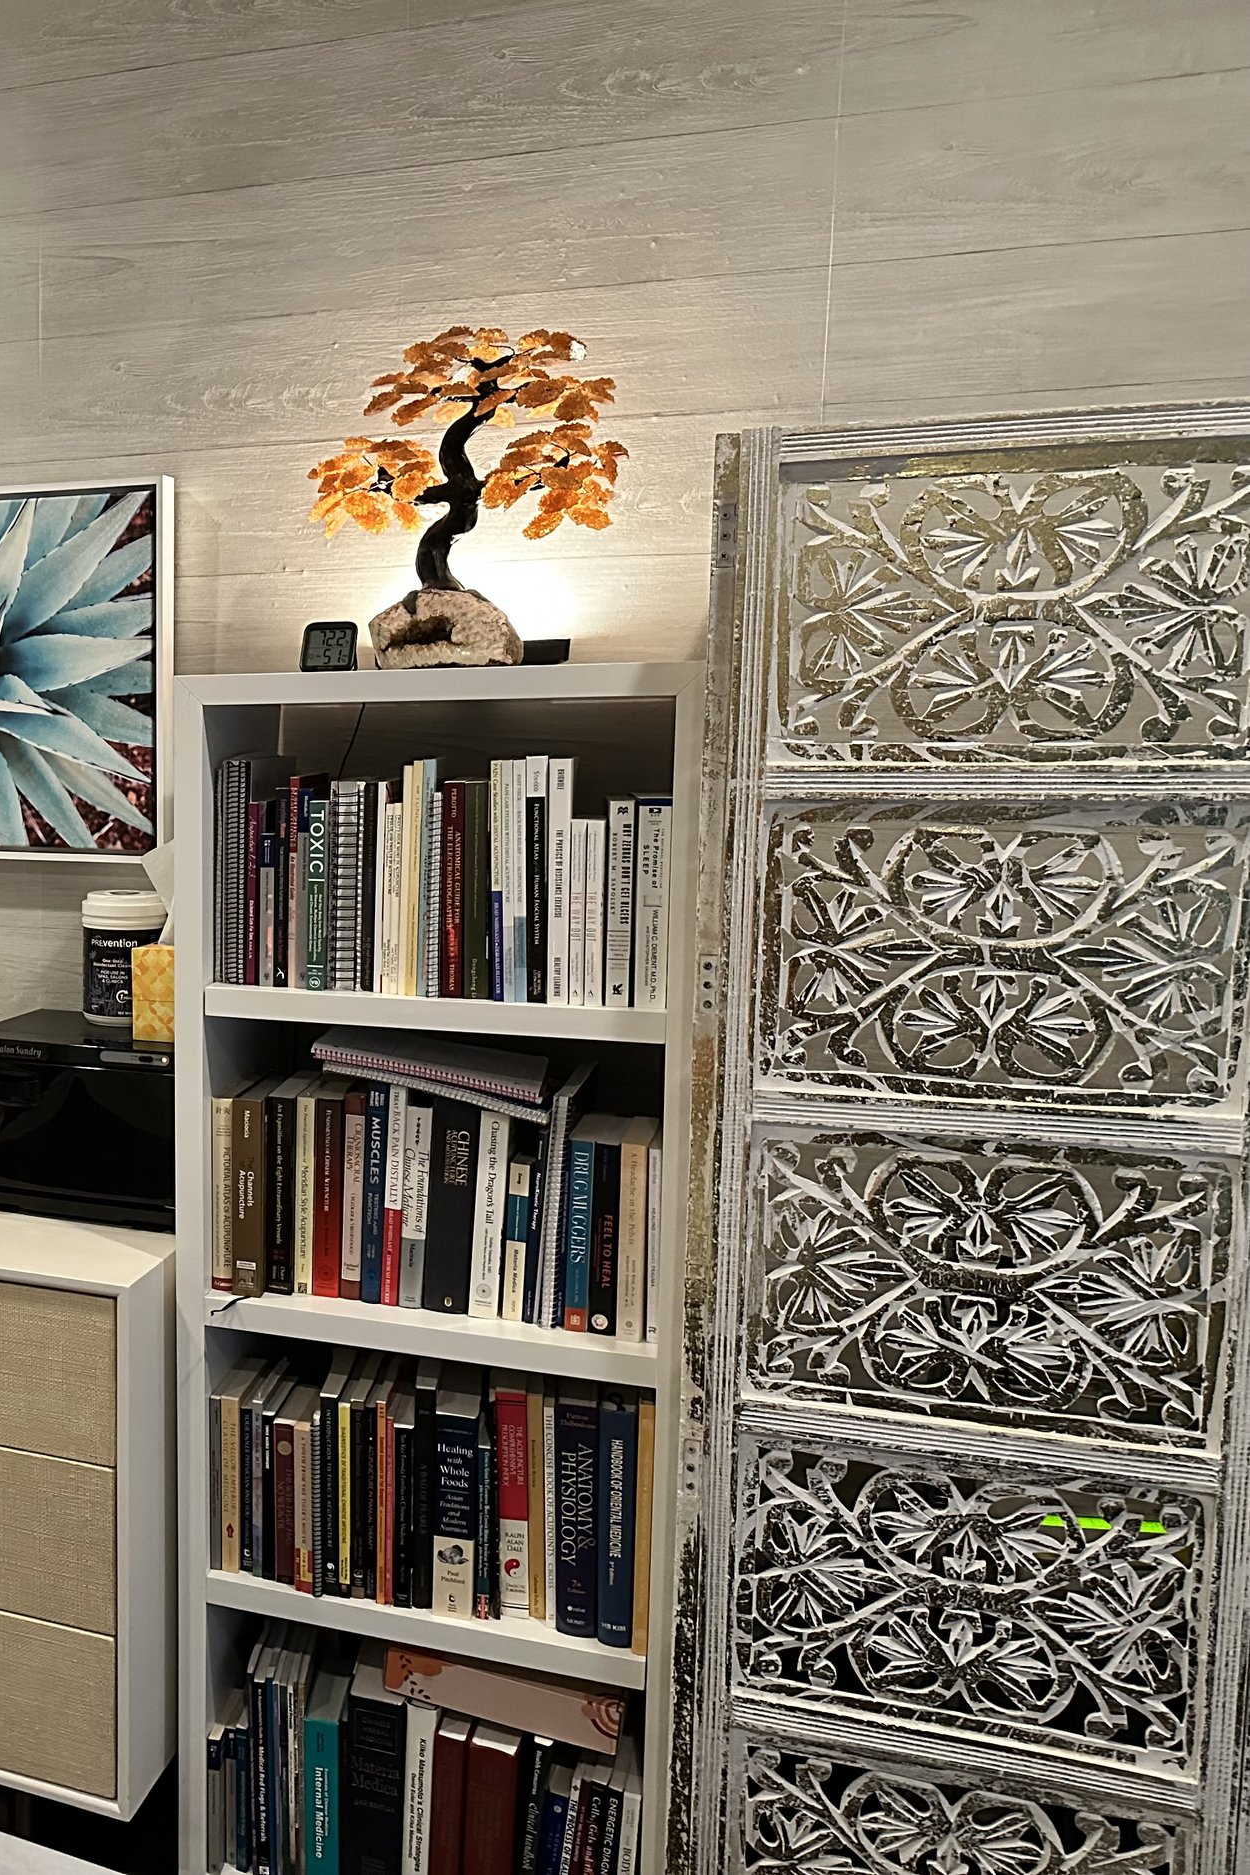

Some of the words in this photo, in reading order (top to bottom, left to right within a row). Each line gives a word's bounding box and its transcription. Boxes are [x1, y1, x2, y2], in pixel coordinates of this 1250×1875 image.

[310, 810, 324, 873] TOXIC
[556, 830, 564, 838] THE
[623, 824, 632, 837] WHY
[556, 840, 564, 860] PHYSICS
[622, 840, 631, 863] ZEBRAS
[652, 846, 660, 878] Promise
[555, 868, 564, 896] RESISTANCE
[620, 888, 630, 898] GET
[652, 880, 658, 888] of
[554, 897, 563, 918] EXERCISE
[571, 892, 581, 905] THE
[587, 892, 597, 905] THE
[571, 909, 581, 924] WAY
[587, 909, 597, 924] WAY
[620, 902, 630, 925] ULCERS
[571, 928, 581, 941] OUT
[587, 928, 597, 942] OUT
[16, 1047, 42, 1058] Sundry
[277, 1104, 283, 1113] An
[243, 1110, 251, 1138] Maciocia
[275, 1114, 283, 1144] Exposition
[392, 1111, 401, 1135] BACK
[277, 1146, 282, 1154] on
[391, 1137, 400, 1158] PAIN
[488, 1121, 500, 1155] Chasing
[346, 1136, 355, 1170] THERAPY
[353, 1123, 363, 1184] CRANIOSACRAL
[370, 1117, 381, 1184] MUSCLES
[418, 1151, 429, 1168] The
[448, 1130, 458, 1184] ACUPUNCTURE
[456, 1130, 470, 1186] CHINESE
[275, 1166, 283, 1181] Eight
[404, 1148, 415, 1182] Chinese
[489, 1157, 498, 1170] the
[574, 1151, 590, 1190] DRUG
[301, 1166, 309, 1196] Meridian
[389, 1160, 399, 1206] DISTALLY
[485, 1172, 497, 1207] Dragon's
[533, 1173, 542, 1207] NeuroKinetic
[630, 1160, 638, 1196] Headache
[238, 1170, 246, 1219] Acupuncture
[275, 1183, 283, 1222] Extraordinary
[300, 1198, 308, 1214] Style
[402, 1185, 414, 1227] Medicine
[415, 1170, 427, 1223] Foundations
[630, 1199, 637, 1207] in
[485, 1210, 495, 1224] Tail
[530, 1209, 539, 1230] Therapy
[604, 1214, 614, 1239] FEEL
[629, 1209, 637, 1222] the
[299, 1215, 308, 1259] Acupuncture
[413, 1225, 424, 1234] of
[570, 1195, 588, 1263] MUGGERS
[628, 1224, 636, 1245] Pelvis
[603, 1244, 613, 1257] TO
[602, 1261, 612, 1288] HEAL
[545, 1414, 553, 1430] THE
[437, 1443, 473, 1457] Healing
[545, 1432, 554, 1470] CONCISE
[610, 1439, 624, 1480] HANDBOOK
[222, 1458, 229, 1469] OF
[326, 1463, 332, 1472] TO
[440, 1465, 470, 1477] Whole
[441, 1477, 469, 1488] Foods
[546, 1472, 554, 1496] BOOK
[577, 1443, 594, 1533] ANATOMY
[610, 1480, 623, 1490] OF
[546, 1497, 554, 1508] OF
[560, 1451, 577, 1567] PHYSIOLOGY
[610, 1491, 623, 1524] ORIENTAL
[546, 1510, 554, 1557] ACUPOINTS
[577, 1536, 596, 1550] &
[609, 1524, 622, 1558] MEDICINE
[507, 1544, 524, 1553] DALE
[419, 1738, 427, 1758] Kiiko
[315, 1767, 324, 1808] Internal
[417, 1760, 426, 1806] Matsumoto's
[258, 1788, 266, 1804] Flags
[416, 1807, 424, 1834] Clinical
[526, 1803, 538, 1833] Clinical
[315, 1811, 324, 1859] Medicine
[414, 1835, 422, 1873] Strategies
[522, 1835, 534, 1871] Handbook
[621, 1847, 632, 1874] BODY
